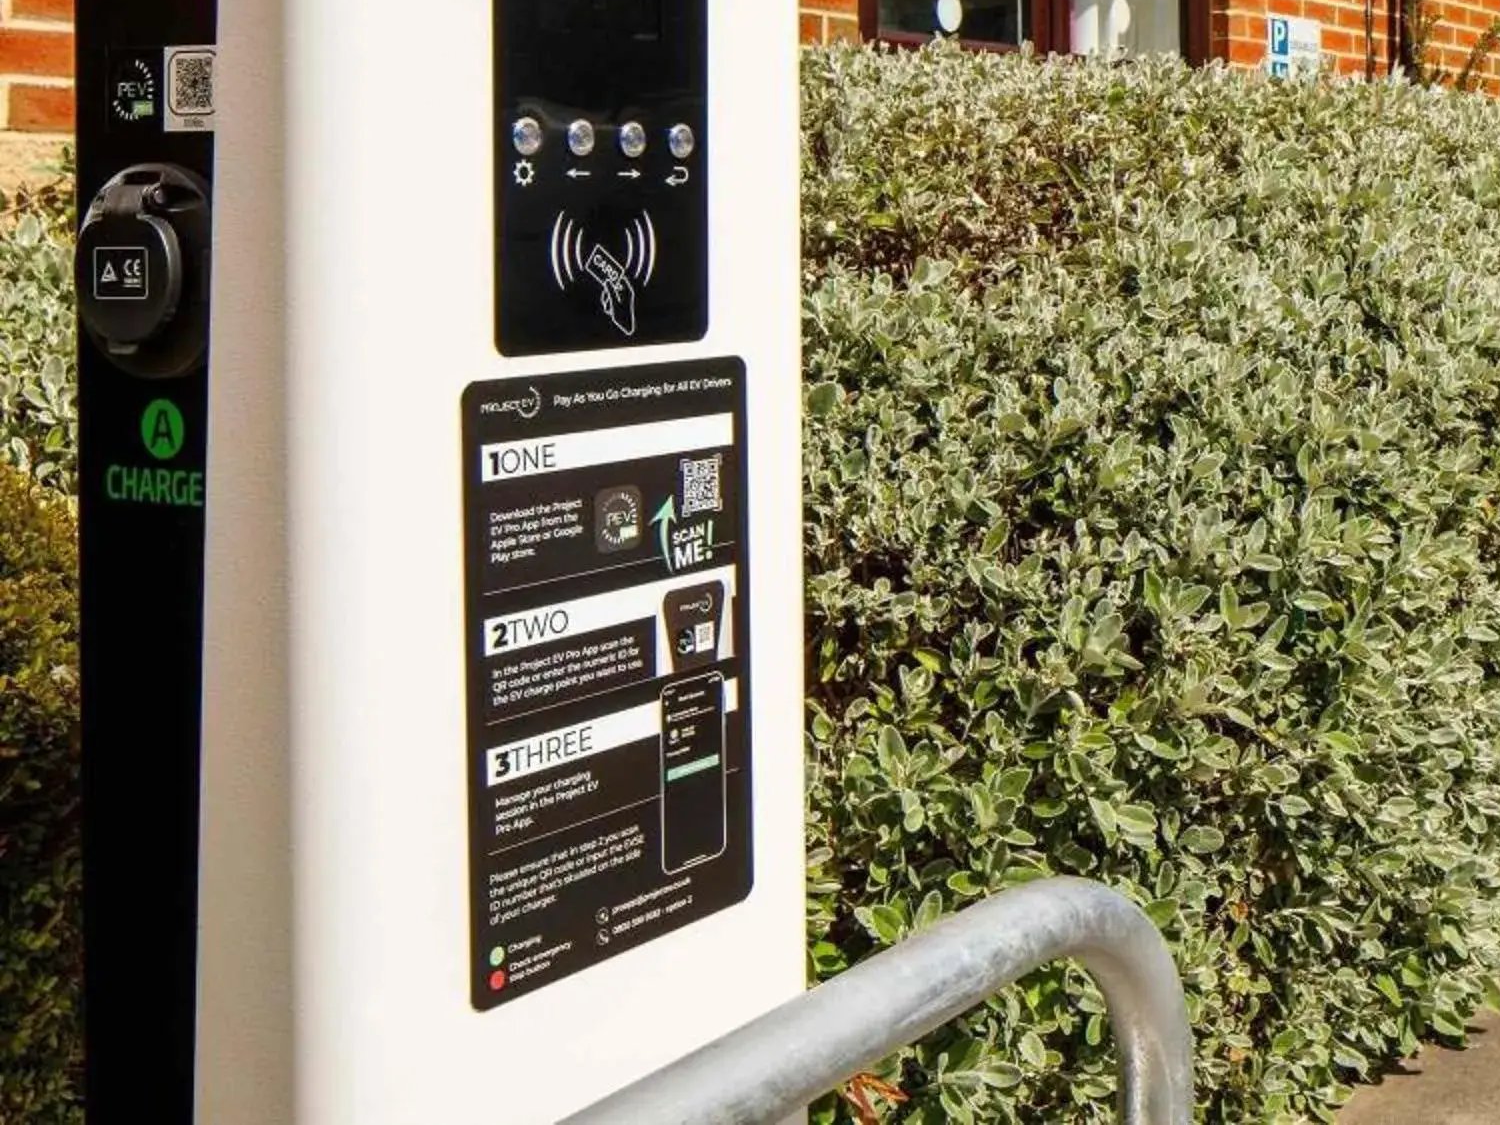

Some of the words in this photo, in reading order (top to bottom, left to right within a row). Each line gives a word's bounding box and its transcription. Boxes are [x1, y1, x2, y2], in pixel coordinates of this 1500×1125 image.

[553, 394, 572, 407] Pay
[573, 392, 586, 404] As
[587, 390, 605, 402] You
[621, 384, 661, 398] Charging
[663, 382, 676, 394] for
[678, 380, 688, 392] All
[703, 377, 732, 390] Drivers
[106, 464, 204, 507] CHARGE
[489, 506, 535, 523] Download
[536, 503, 551, 516] the
[521, 519, 540, 532] App
[541, 516, 562, 528] from
[673, 522, 705, 546] SCAN
[553, 771, 591, 790] charging
[556, 784, 586, 803] Project
